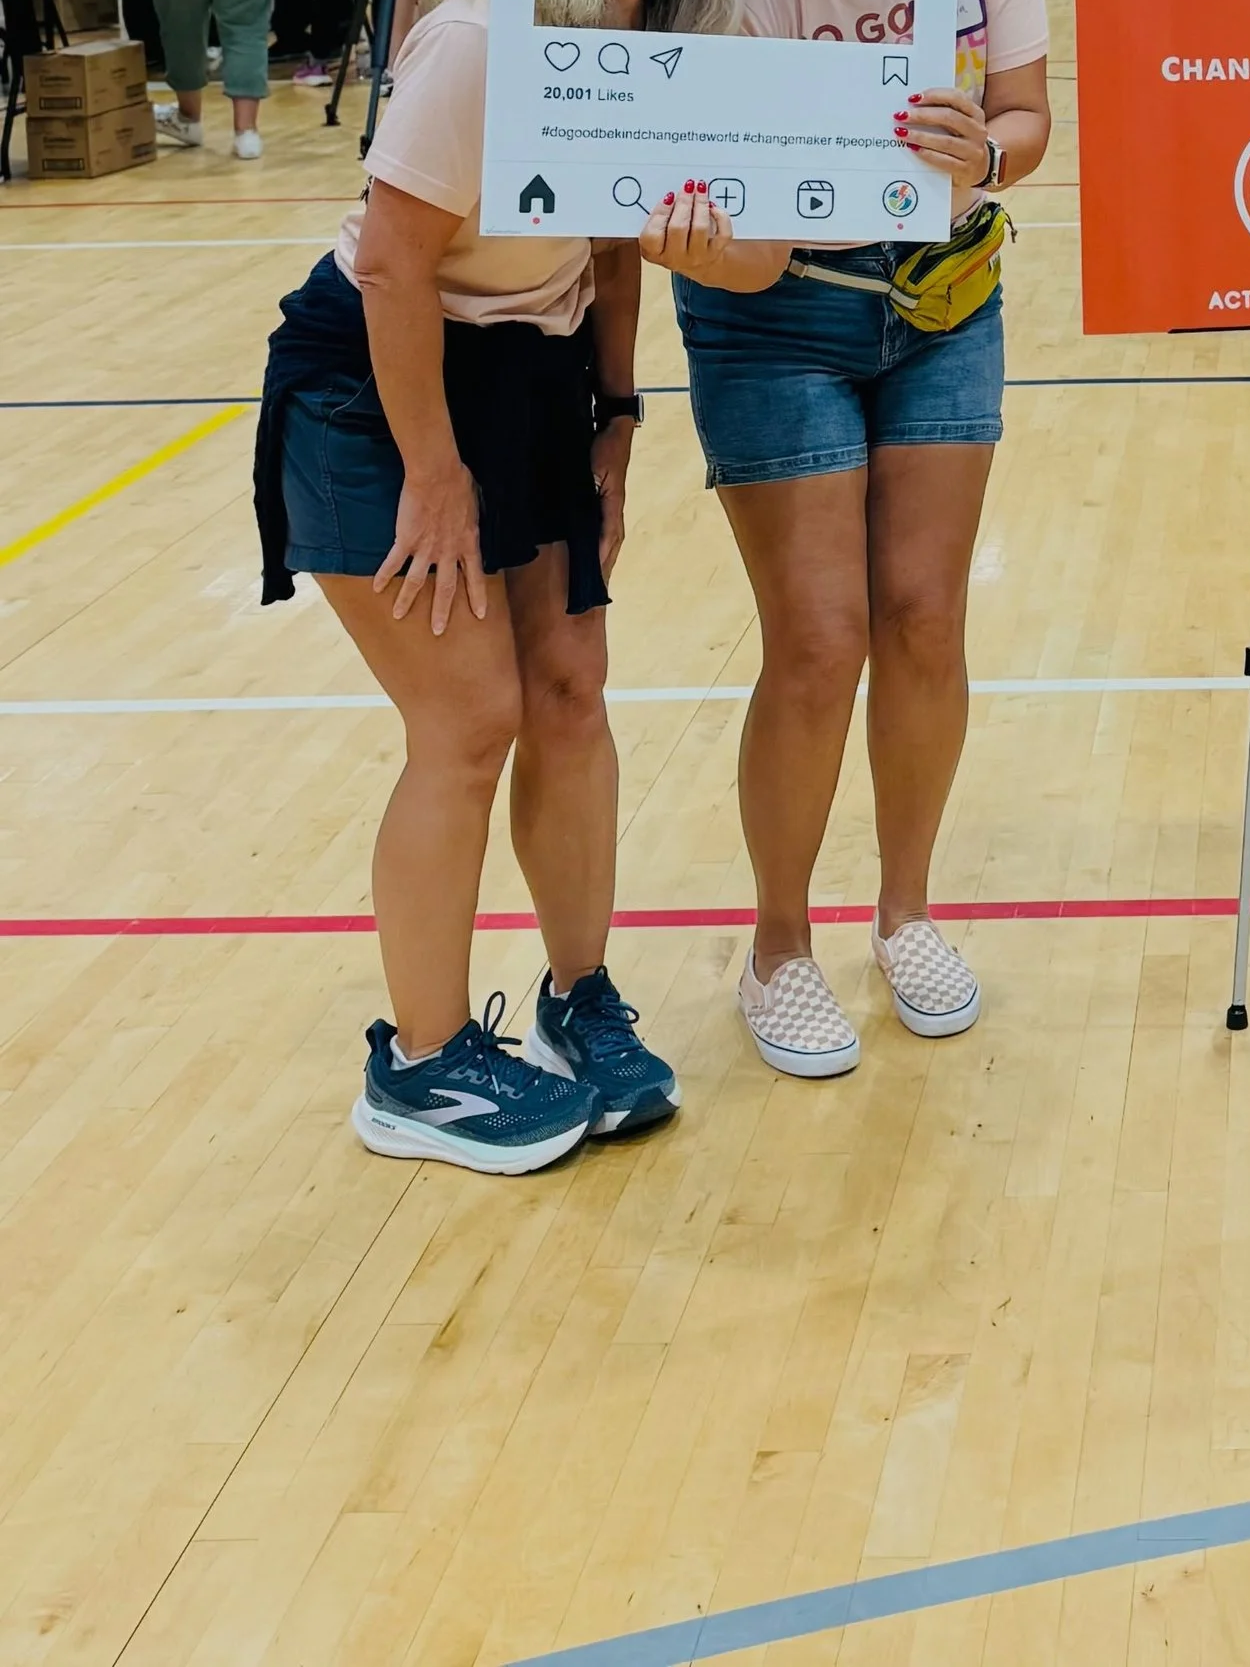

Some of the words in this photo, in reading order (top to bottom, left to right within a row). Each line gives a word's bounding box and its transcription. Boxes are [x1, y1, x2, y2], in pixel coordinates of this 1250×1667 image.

[543, 86, 592, 101] 20,001
[598, 89, 635, 102] Likes
[541, 125, 740, 144] #dogoodbekindchangetheworld
[743, 132, 832, 147] #changemaker
[835, 132, 907, 149] #peoplepow
